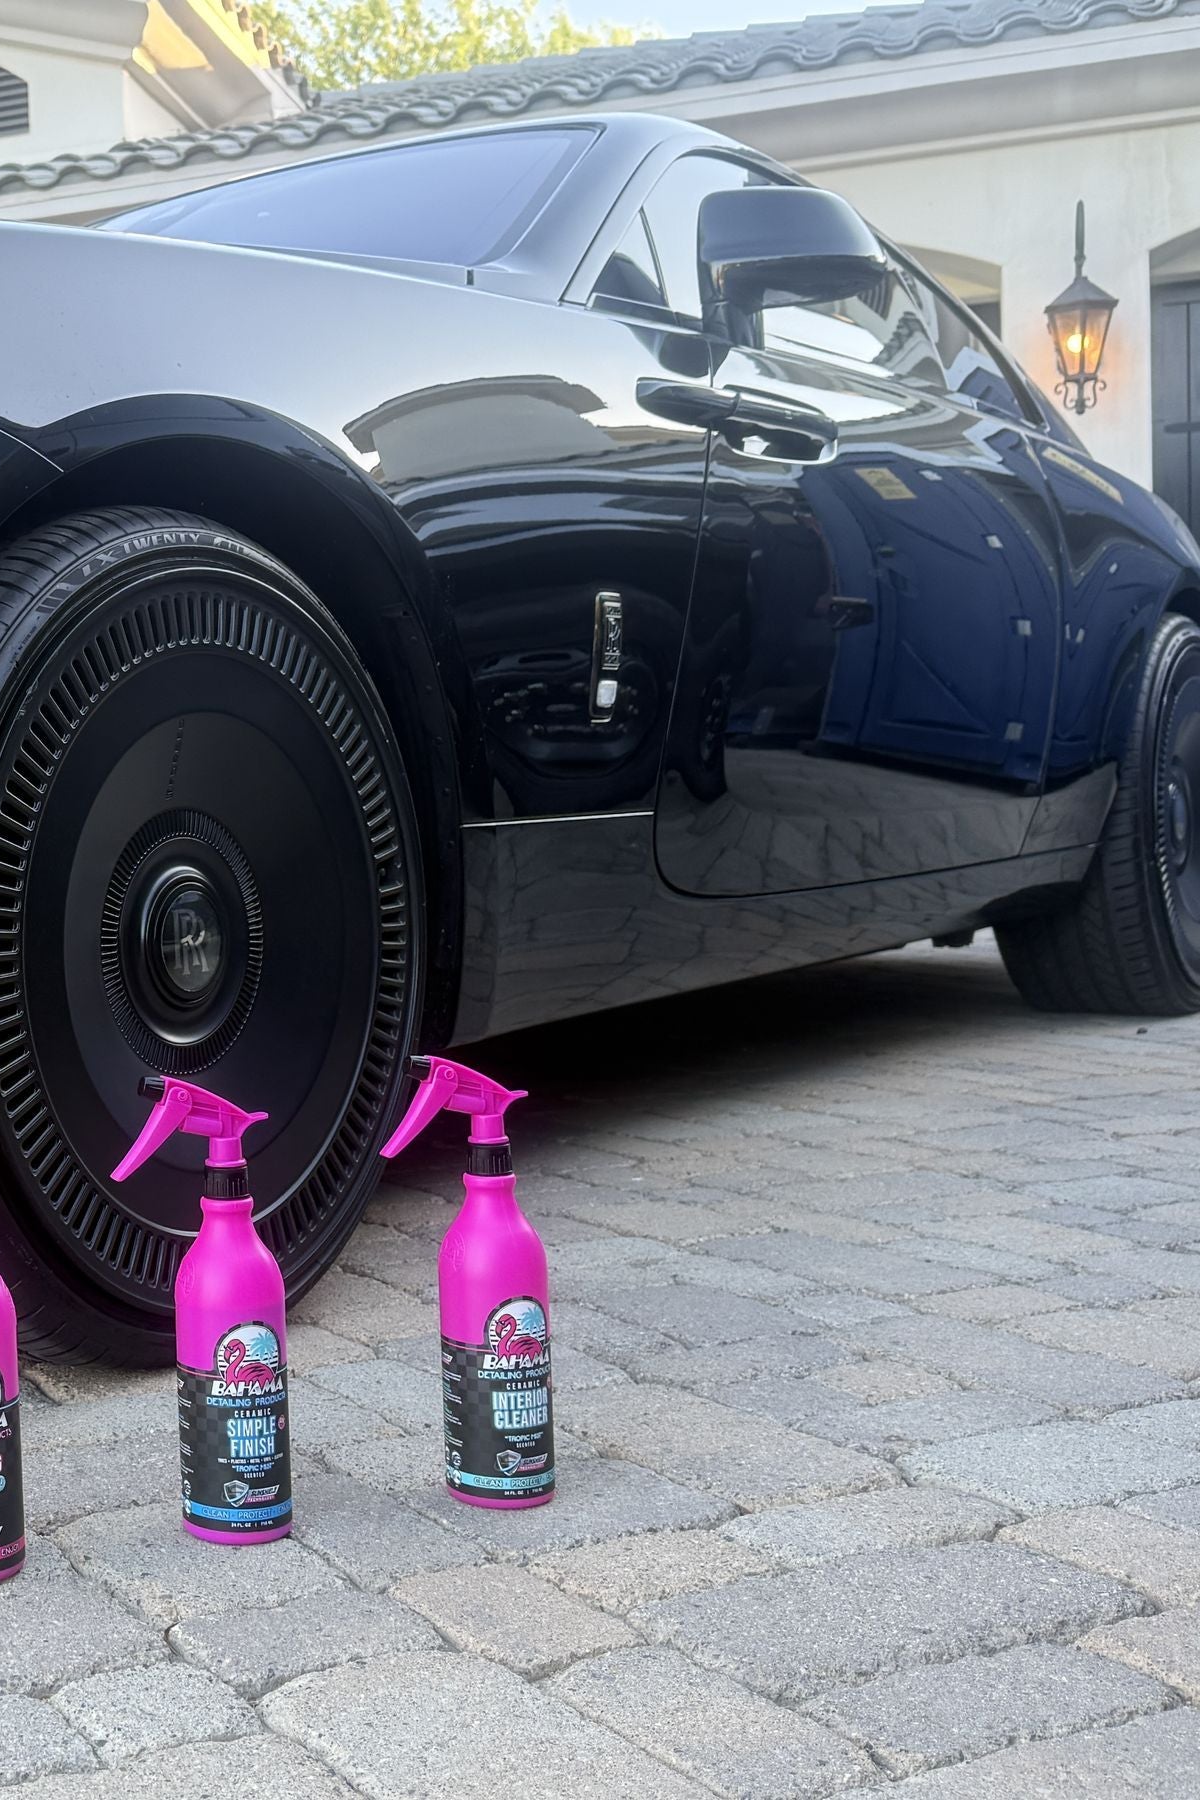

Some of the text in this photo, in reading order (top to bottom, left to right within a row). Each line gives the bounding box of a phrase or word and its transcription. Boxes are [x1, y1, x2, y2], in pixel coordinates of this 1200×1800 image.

[482, 1349, 549, 1370] BAHAMA
[478, 1370, 522, 1379] DETAILING
[211, 1376, 283, 1396] BAHAMA
[506, 1380, 540, 1390] CERAMIC
[206, 1396, 252, 1407] DETAILING
[492, 1386, 548, 1410] INTERIOR
[234, 1408, 271, 1417] CERAMIC
[494, 1406, 548, 1430] CLEANER
[227, 1415, 277, 1437] SIMPLE
[230, 1436, 275, 1458] FINISH
[474, 1477, 503, 1488] CLEAN
[202, 1507, 230, 1519] CLEAN
